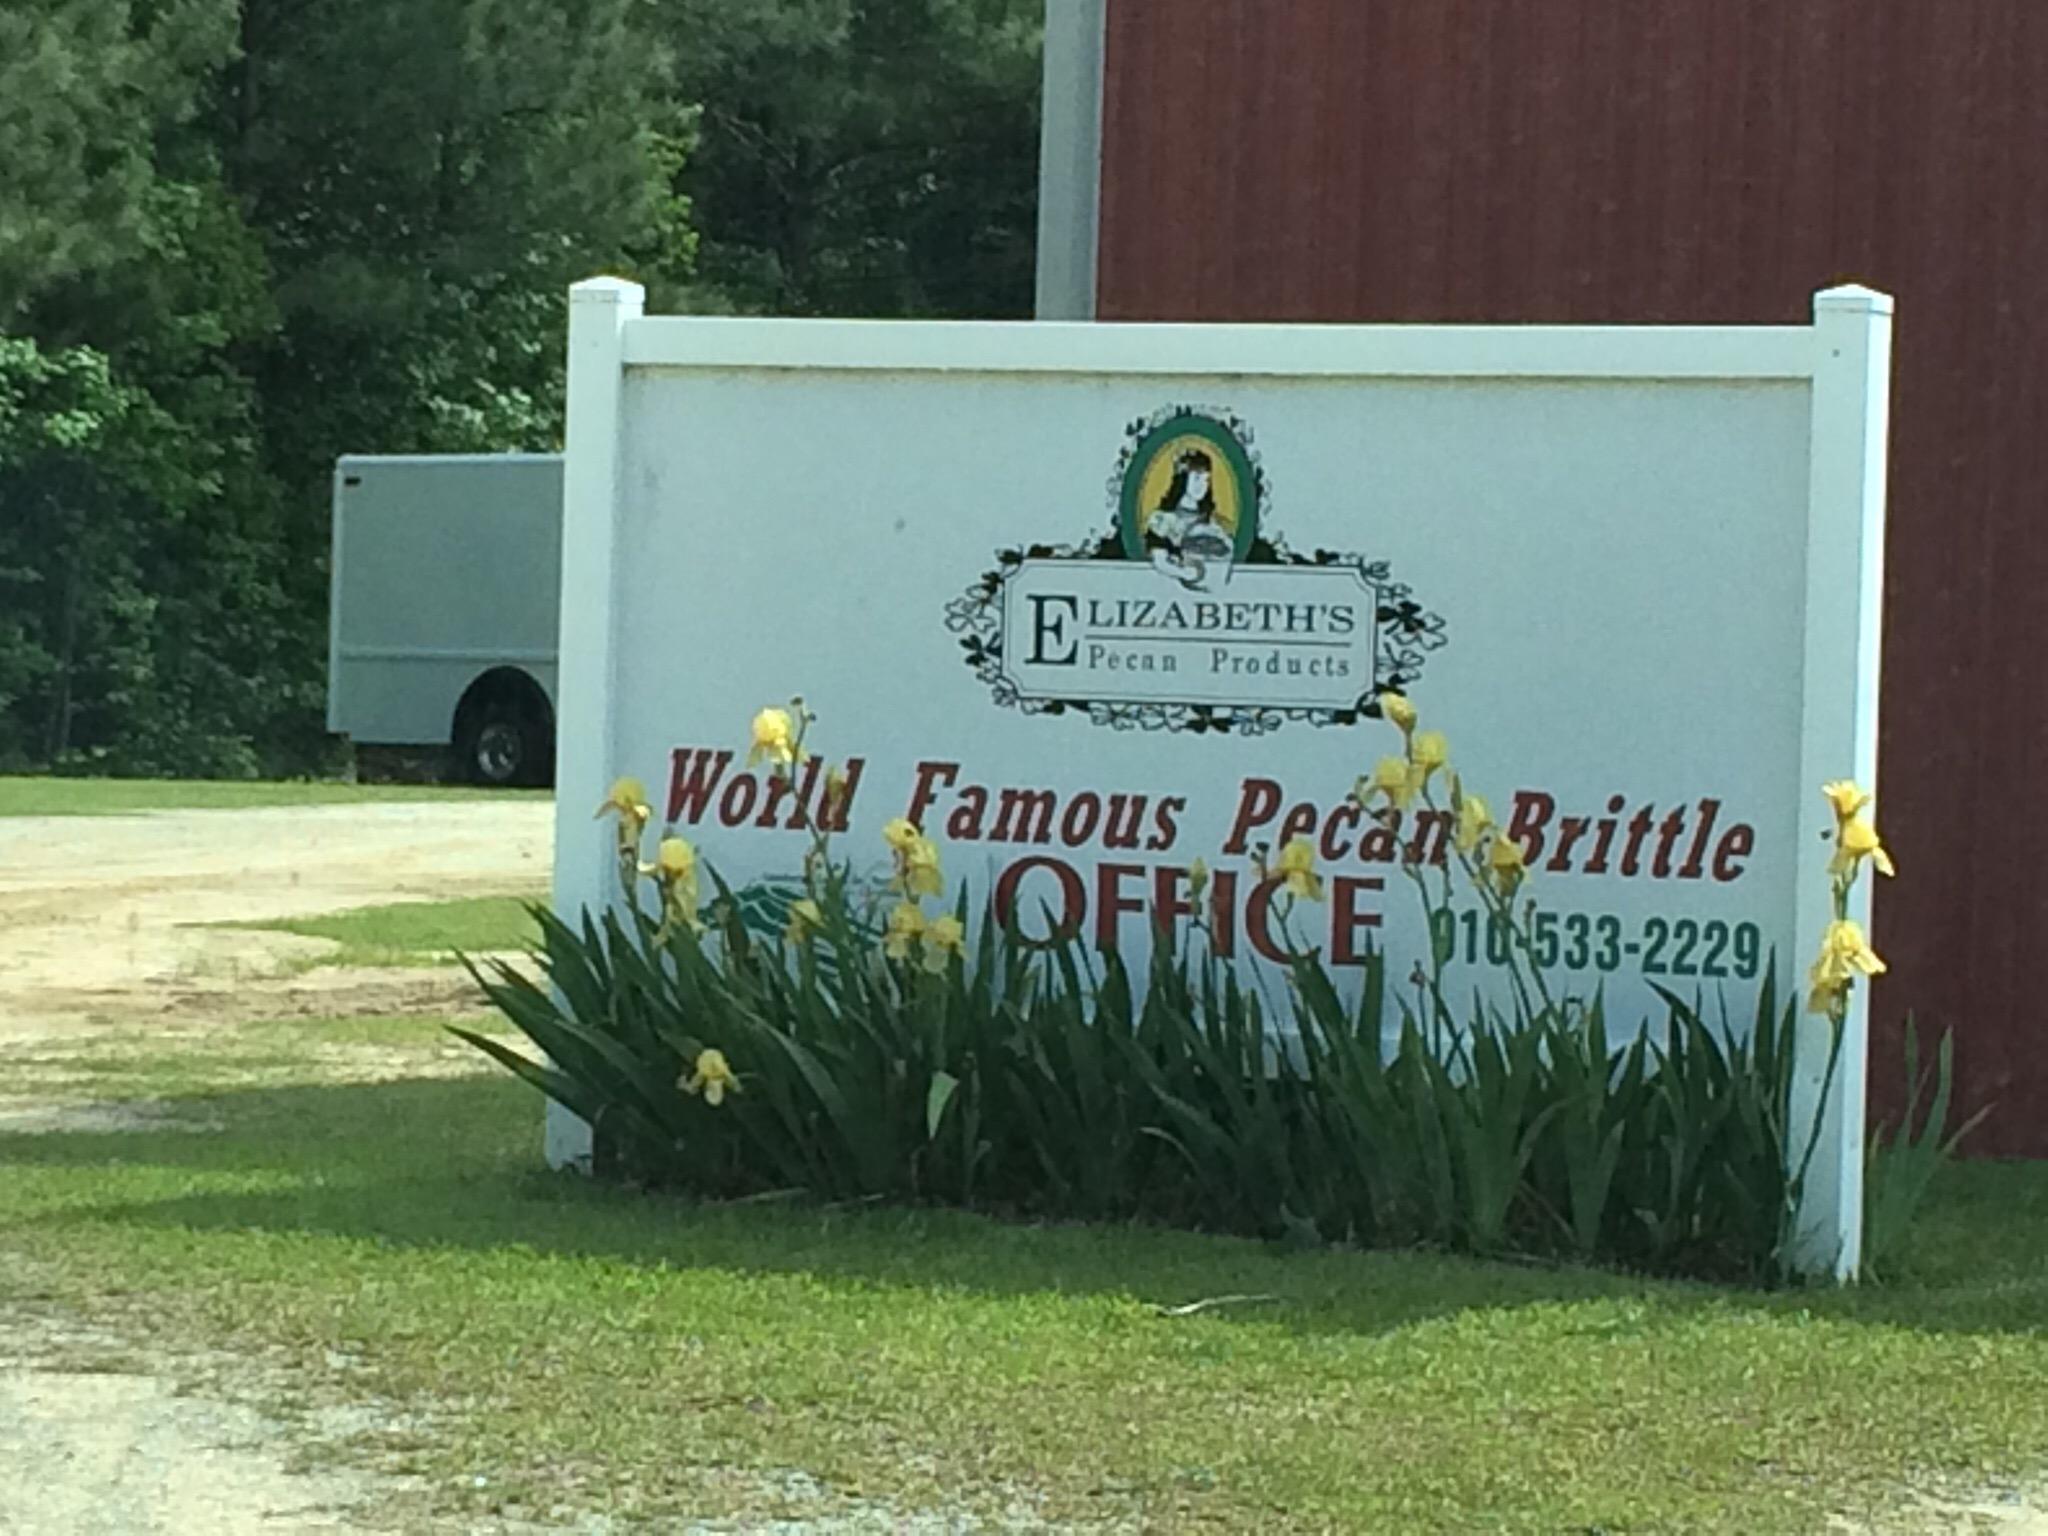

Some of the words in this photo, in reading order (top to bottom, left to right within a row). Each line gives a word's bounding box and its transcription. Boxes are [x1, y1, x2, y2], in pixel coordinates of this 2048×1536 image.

[1025, 594, 1354, 664] ELIZABETH'S
[1089, 643, 1178, 673] Pecan
[1211, 647, 1350, 678] Products
[666, 748, 865, 832] World
[907, 761, 1186, 851] Famous
[1223, 778, 1454, 865] Pecan
[1506, 790, 1754, 882] Brittle
[996, 855, 1384, 966] OFFICE
